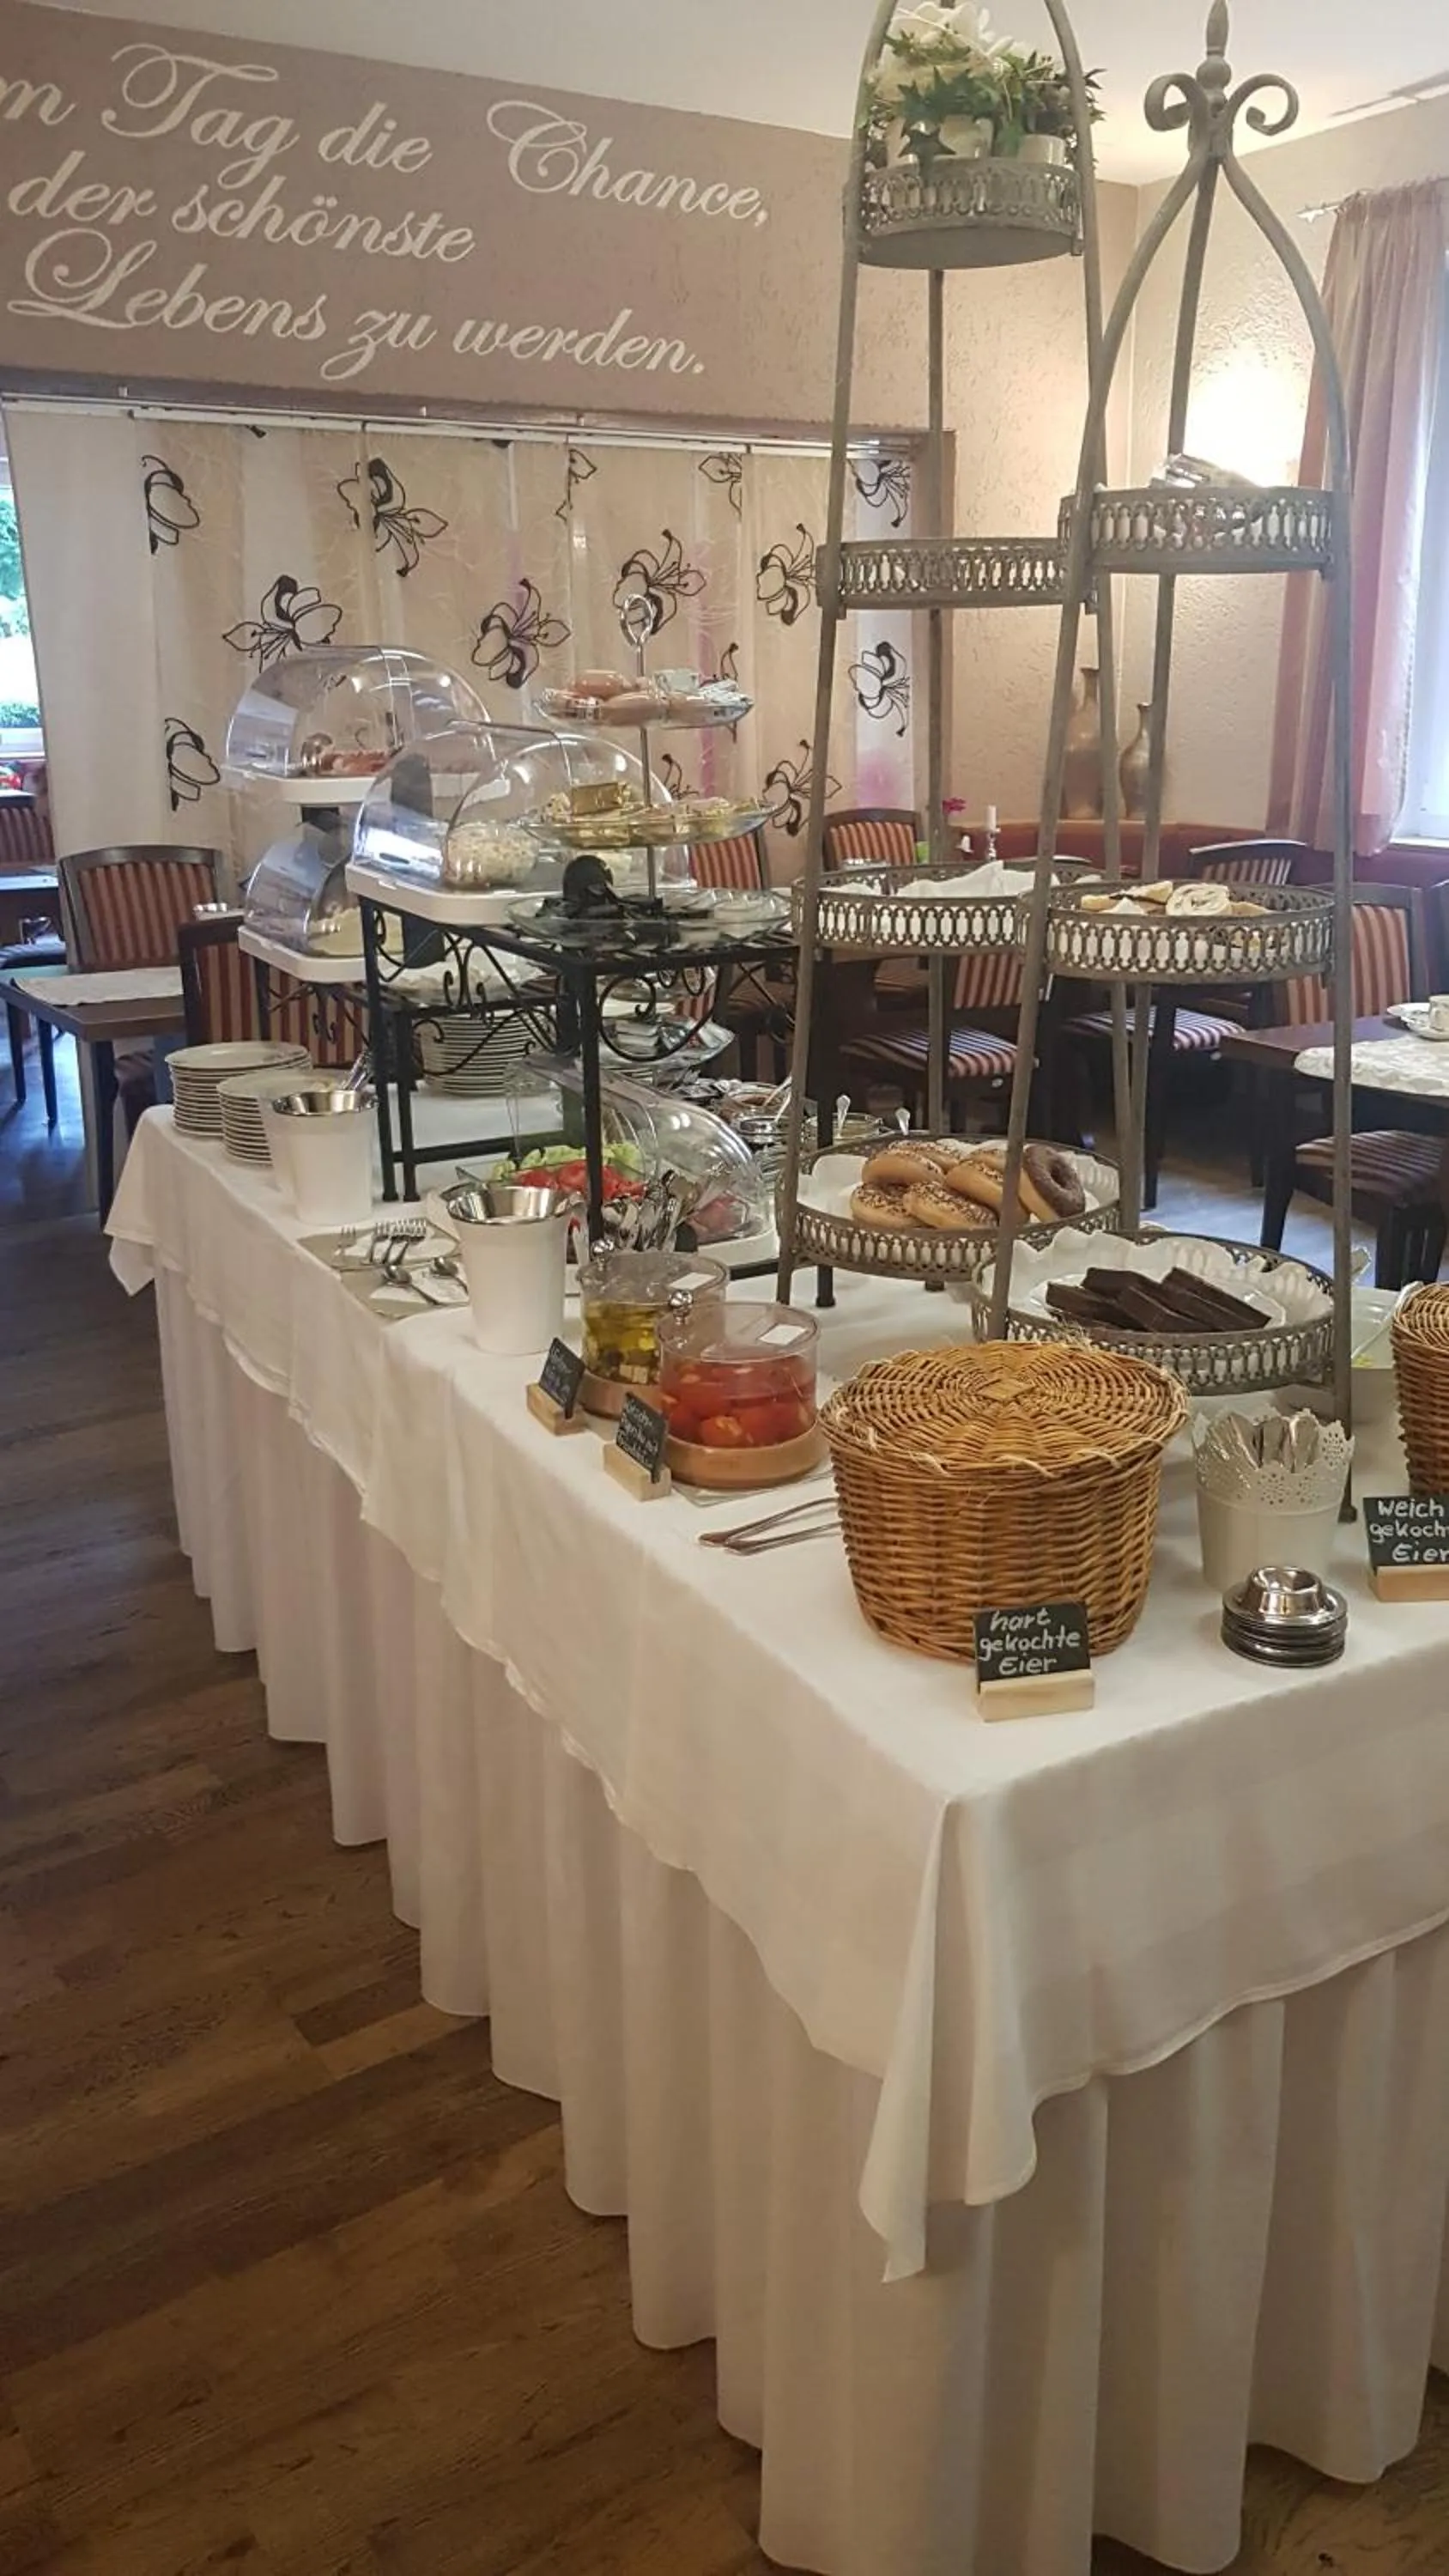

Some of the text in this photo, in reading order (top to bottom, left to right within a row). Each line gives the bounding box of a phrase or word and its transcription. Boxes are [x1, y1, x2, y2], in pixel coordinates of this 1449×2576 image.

[101, 43, 300, 189] Tag
[318, 101, 432, 173] die
[487, 100, 768, 227] Chance,
[8, 150, 476, 262] der schönste
[7, 227, 704, 380] Lebens zu werden.
[1369, 1519, 1449, 1544] gekoch
[990, 1607, 1052, 1631] hart
[979, 1625, 1081, 1662] gekochte
[998, 1652, 1058, 1675] Eier
